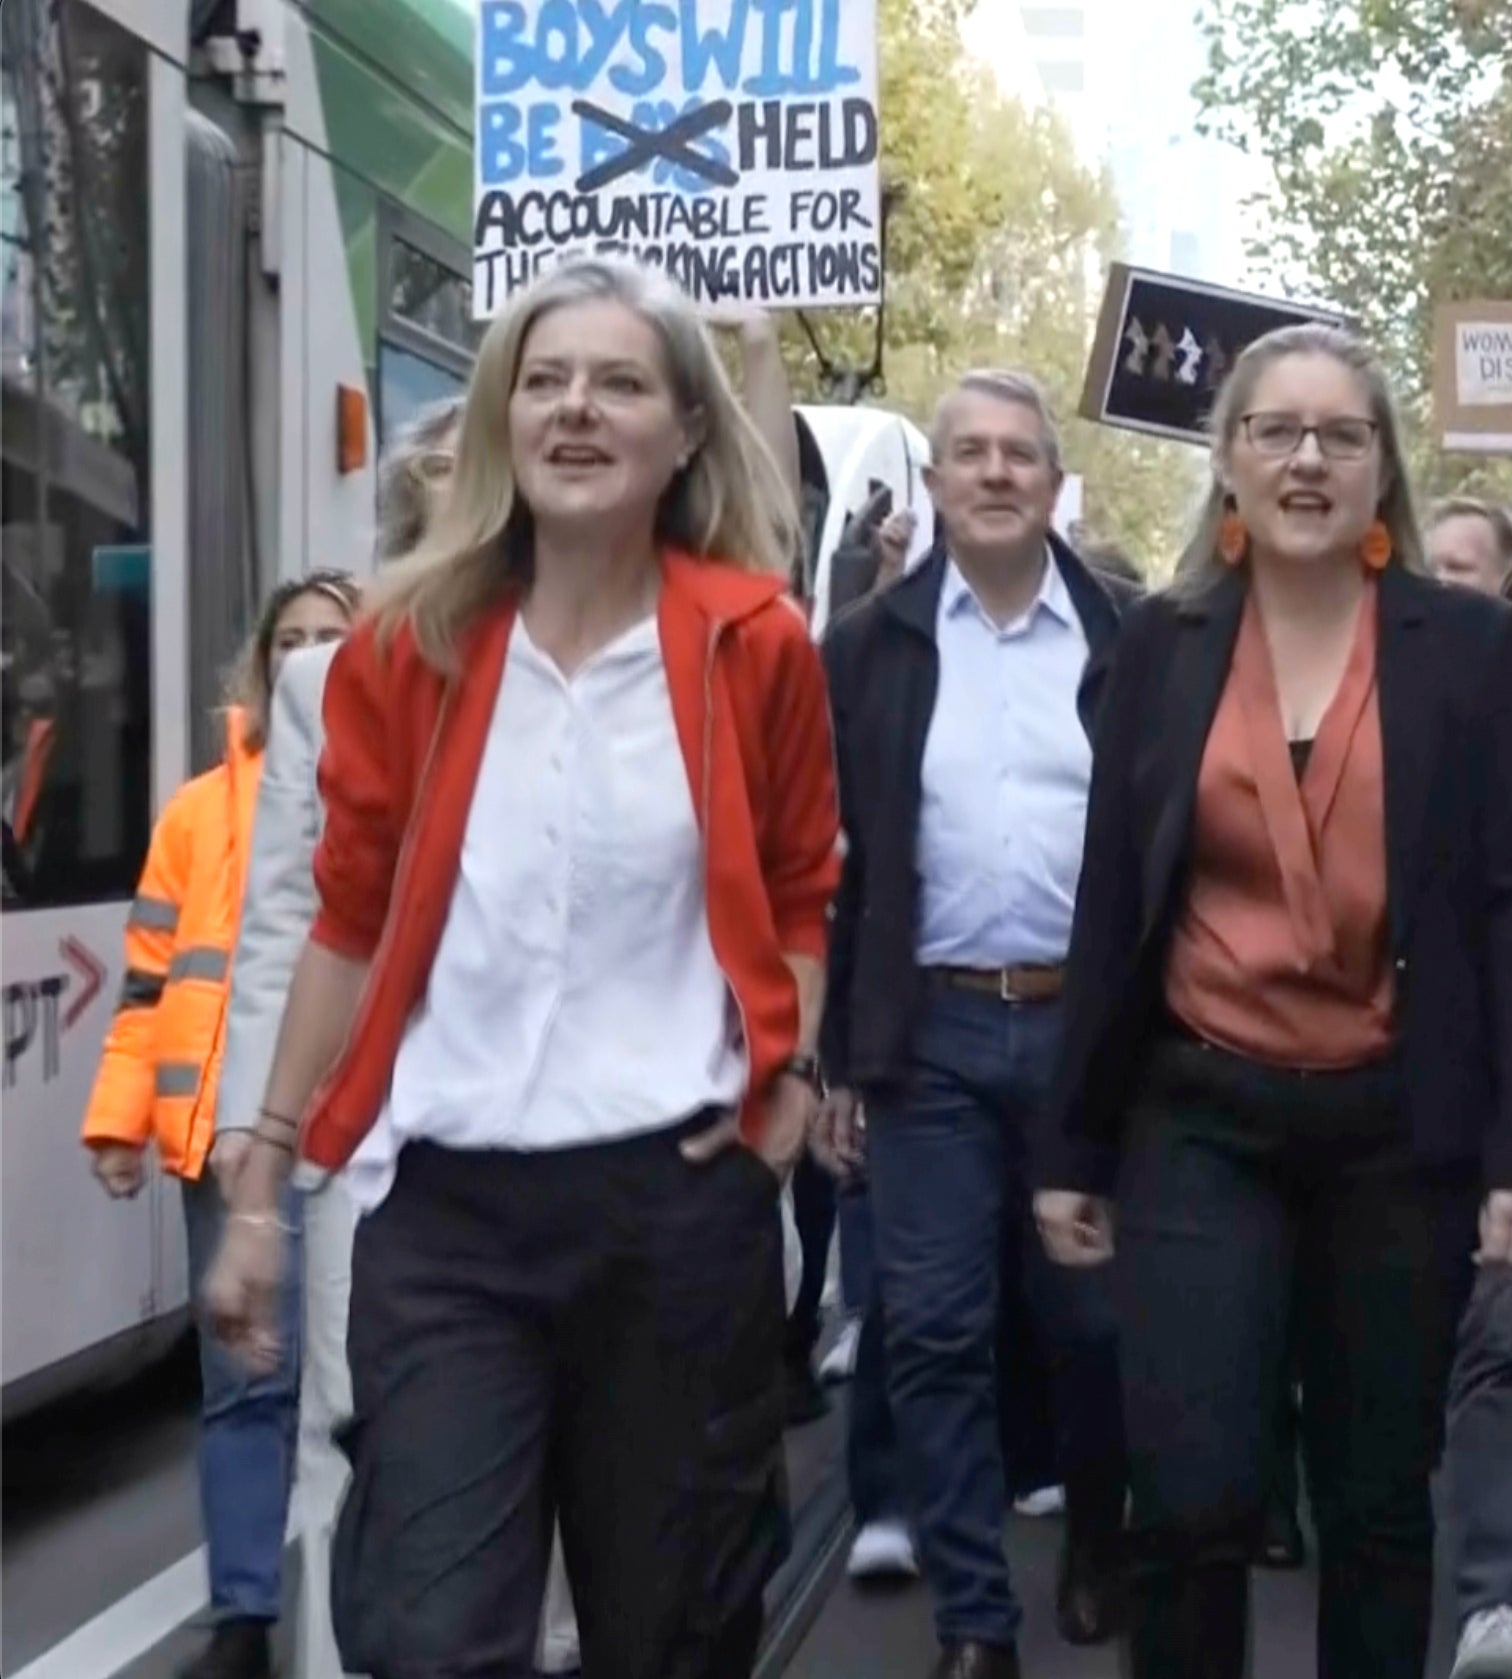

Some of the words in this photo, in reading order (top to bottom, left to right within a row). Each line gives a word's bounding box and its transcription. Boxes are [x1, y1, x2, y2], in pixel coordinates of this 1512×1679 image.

[480, 0, 677, 96] BOYS
[679, 0, 860, 97] WILL
[479, 102, 564, 185] BE
[738, 98, 878, 171] HELD
[475, 189, 769, 249] ACCOUNTABLE
[790, 189, 872, 232] FOR
[594, 240, 740, 302] KING
[742, 243, 880, 299] ACTIONS
